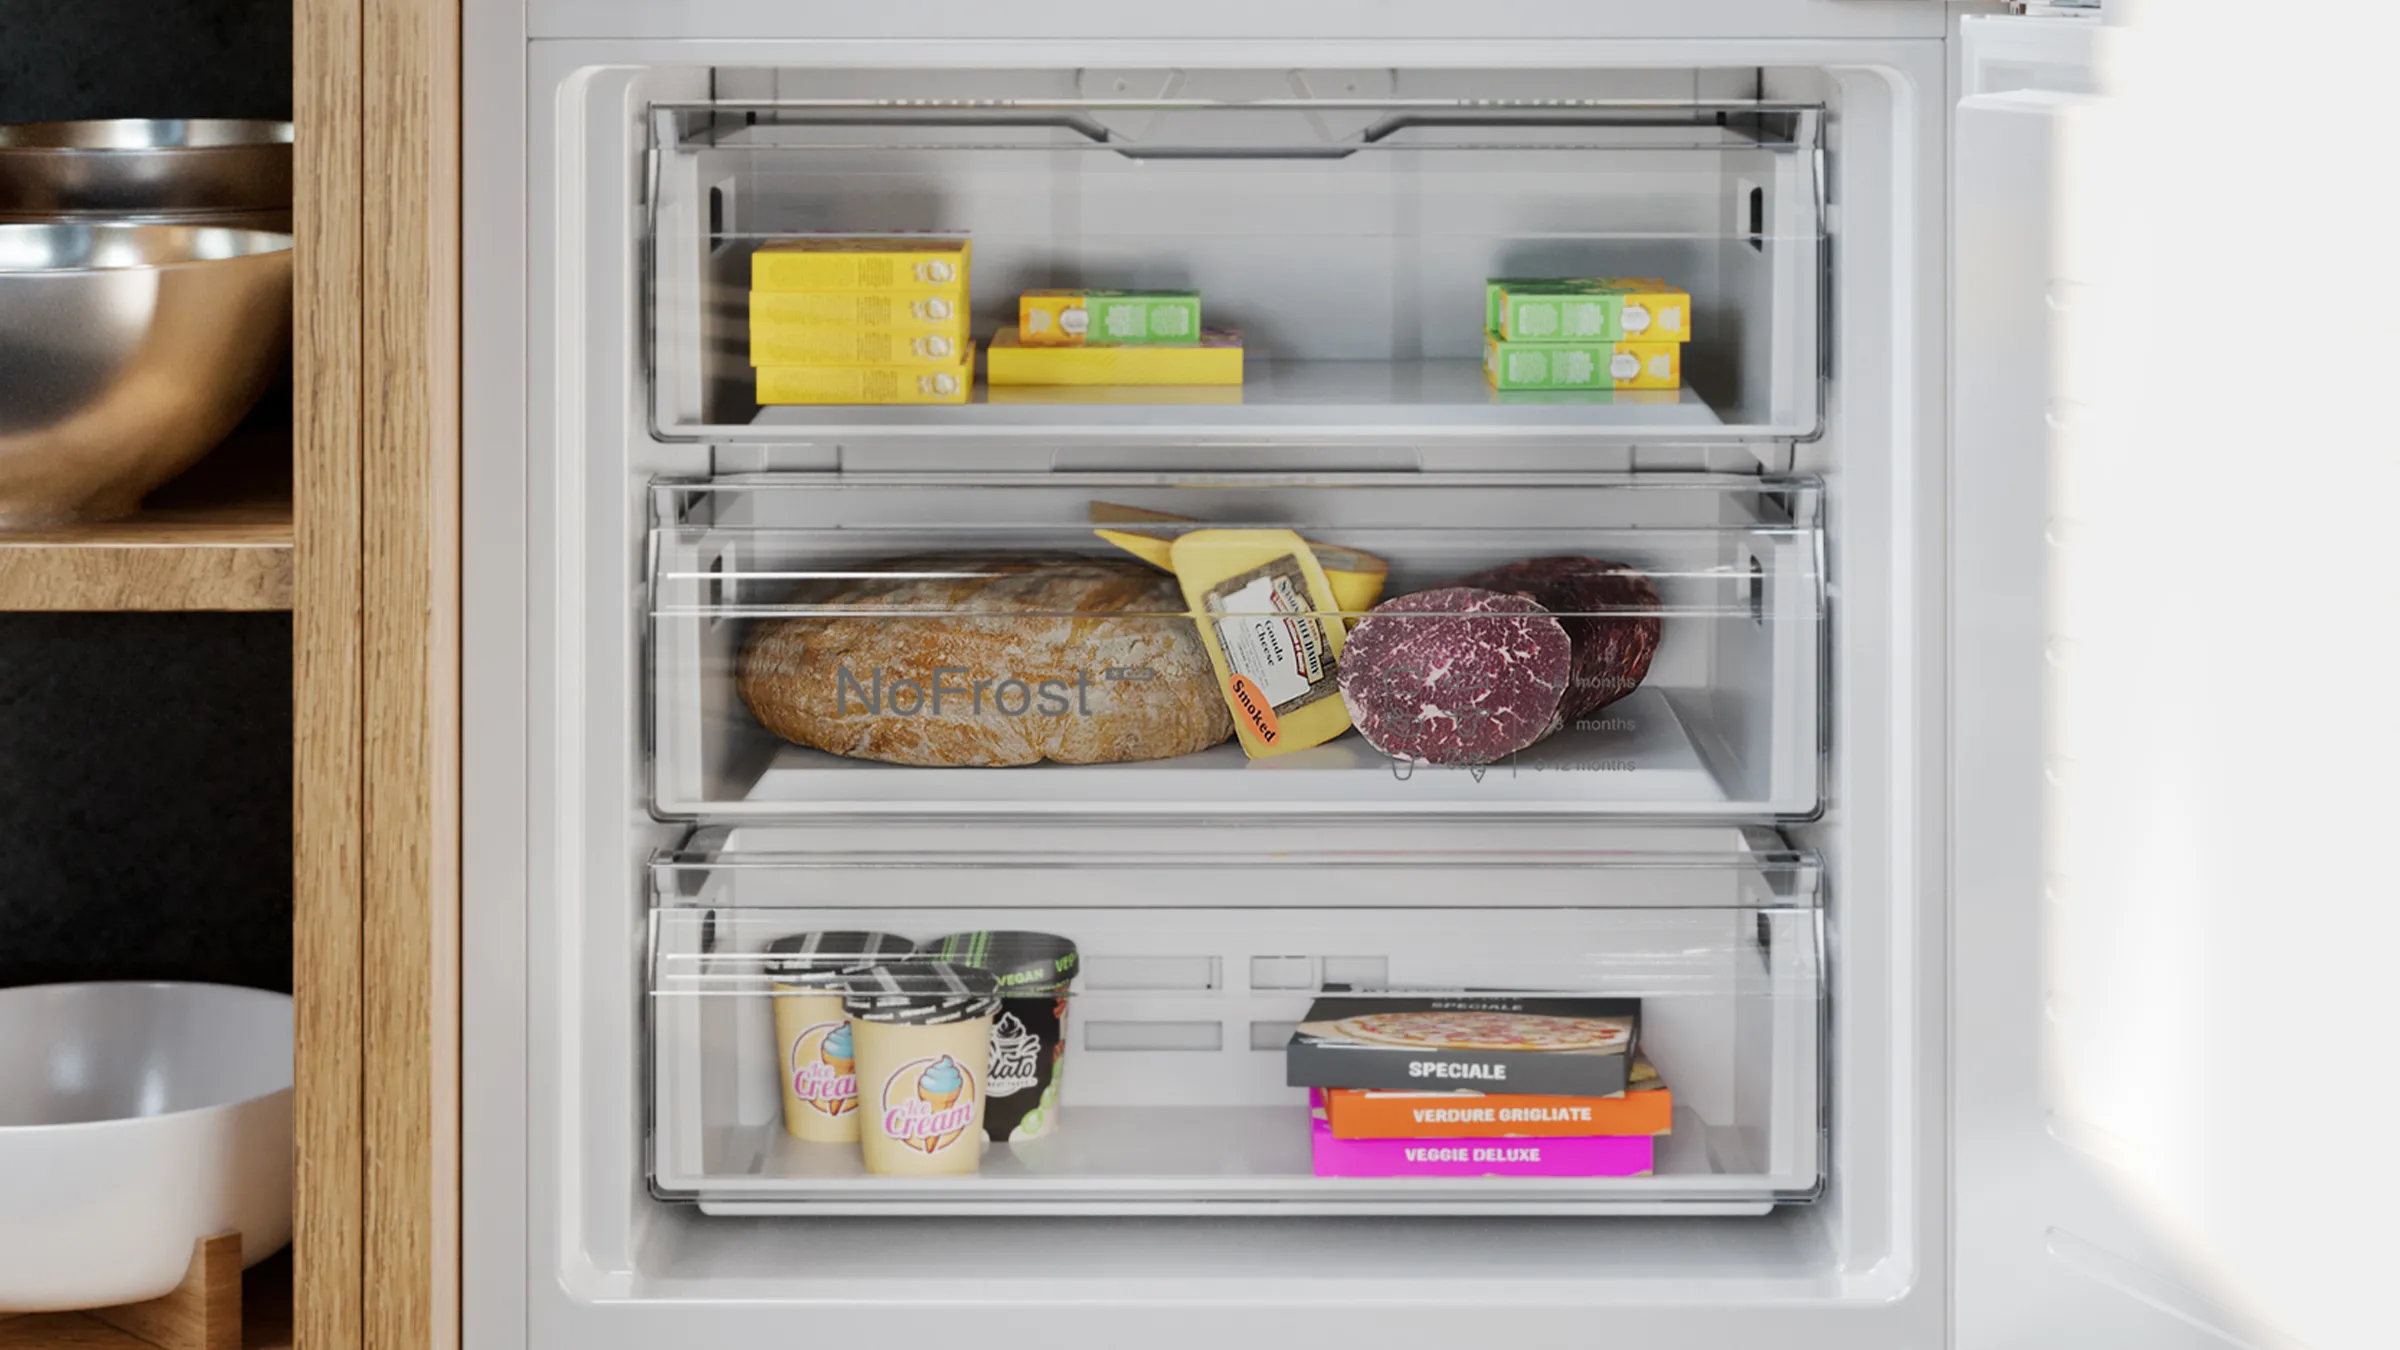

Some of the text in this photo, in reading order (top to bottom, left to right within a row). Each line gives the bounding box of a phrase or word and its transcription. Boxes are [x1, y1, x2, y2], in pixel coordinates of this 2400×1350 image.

[1255, 620, 1275, 667] Cheese
[1264, 618, 1284, 663] Gouda
[836, 667, 1093, 717] NoFrost
[1576, 675, 1636, 689] months
[1232, 679, 1277, 744] Smoked
[1576, 717, 1636, 731] months
[1576, 758, 1636, 772] months
[997, 967, 1044, 987] VEGAN
[1431, 1001, 1524, 1011] SPECIALE
[1408, 1060, 1507, 1081] SPECIALE
[794, 1069, 857, 1097] Crea
[886, 1103, 971, 1136] Cream
[1413, 1106, 1592, 1124] VERDURE GRIGLIATE
[1405, 1147, 1541, 1162] VEGGIE DELUXE
